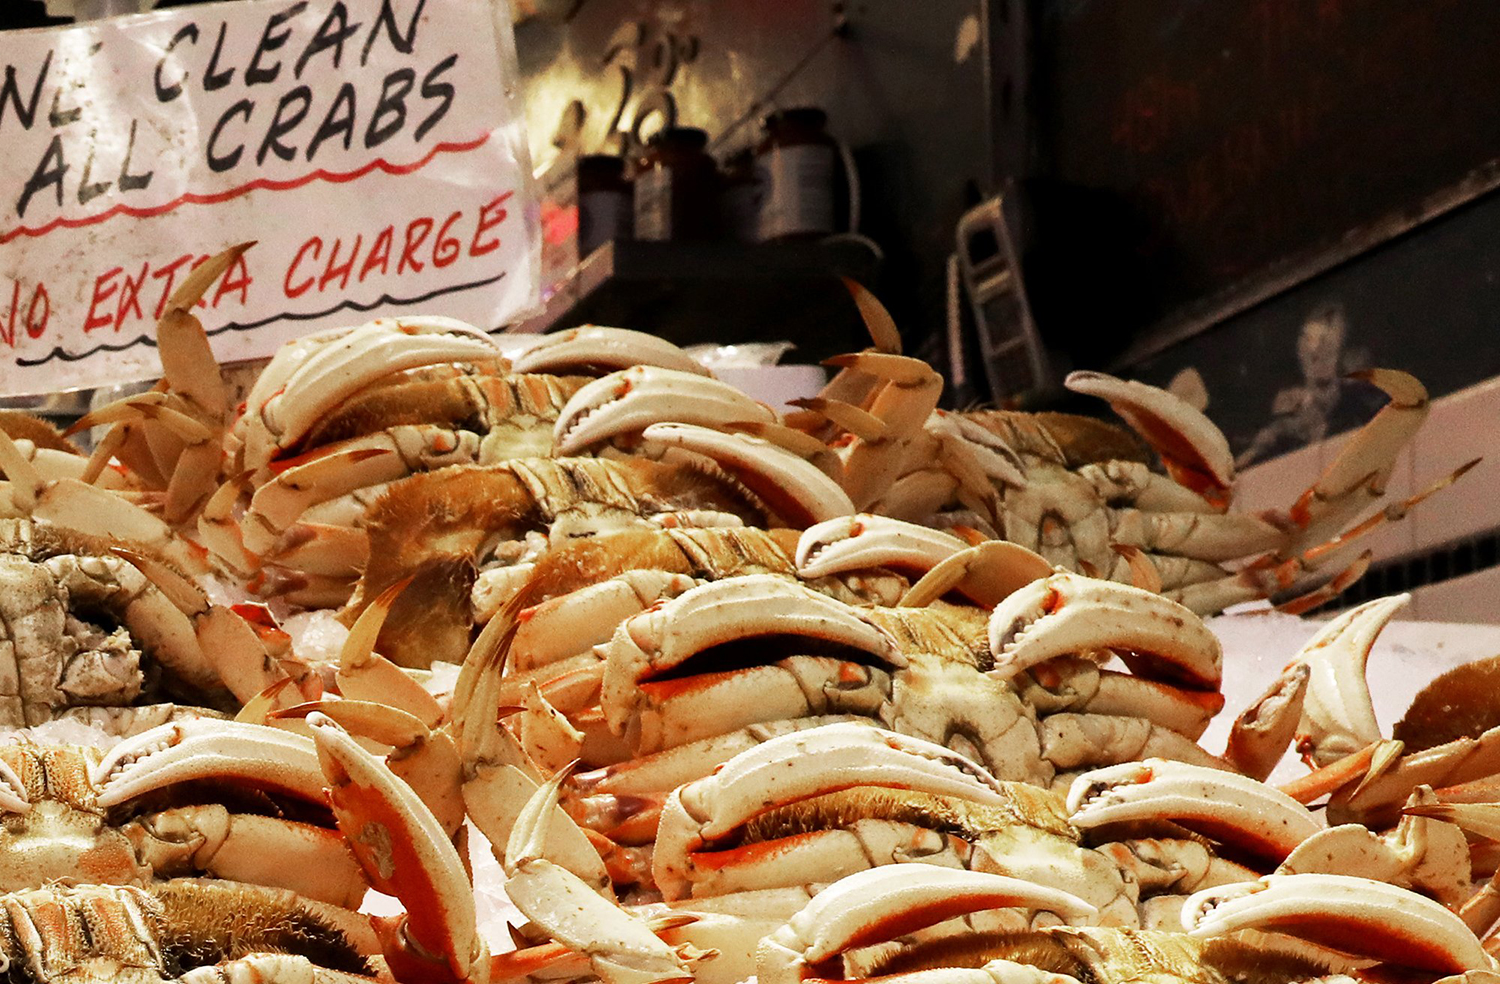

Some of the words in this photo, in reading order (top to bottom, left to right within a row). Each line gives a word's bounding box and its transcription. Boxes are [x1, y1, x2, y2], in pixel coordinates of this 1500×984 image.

[153, 0, 427, 102] CLEAN
[16, 119, 153, 218] ALL
[206, 53, 458, 173] CRABS
[84, 253, 252, 333] EXTA
[283, 189, 514, 299] CHARGE
